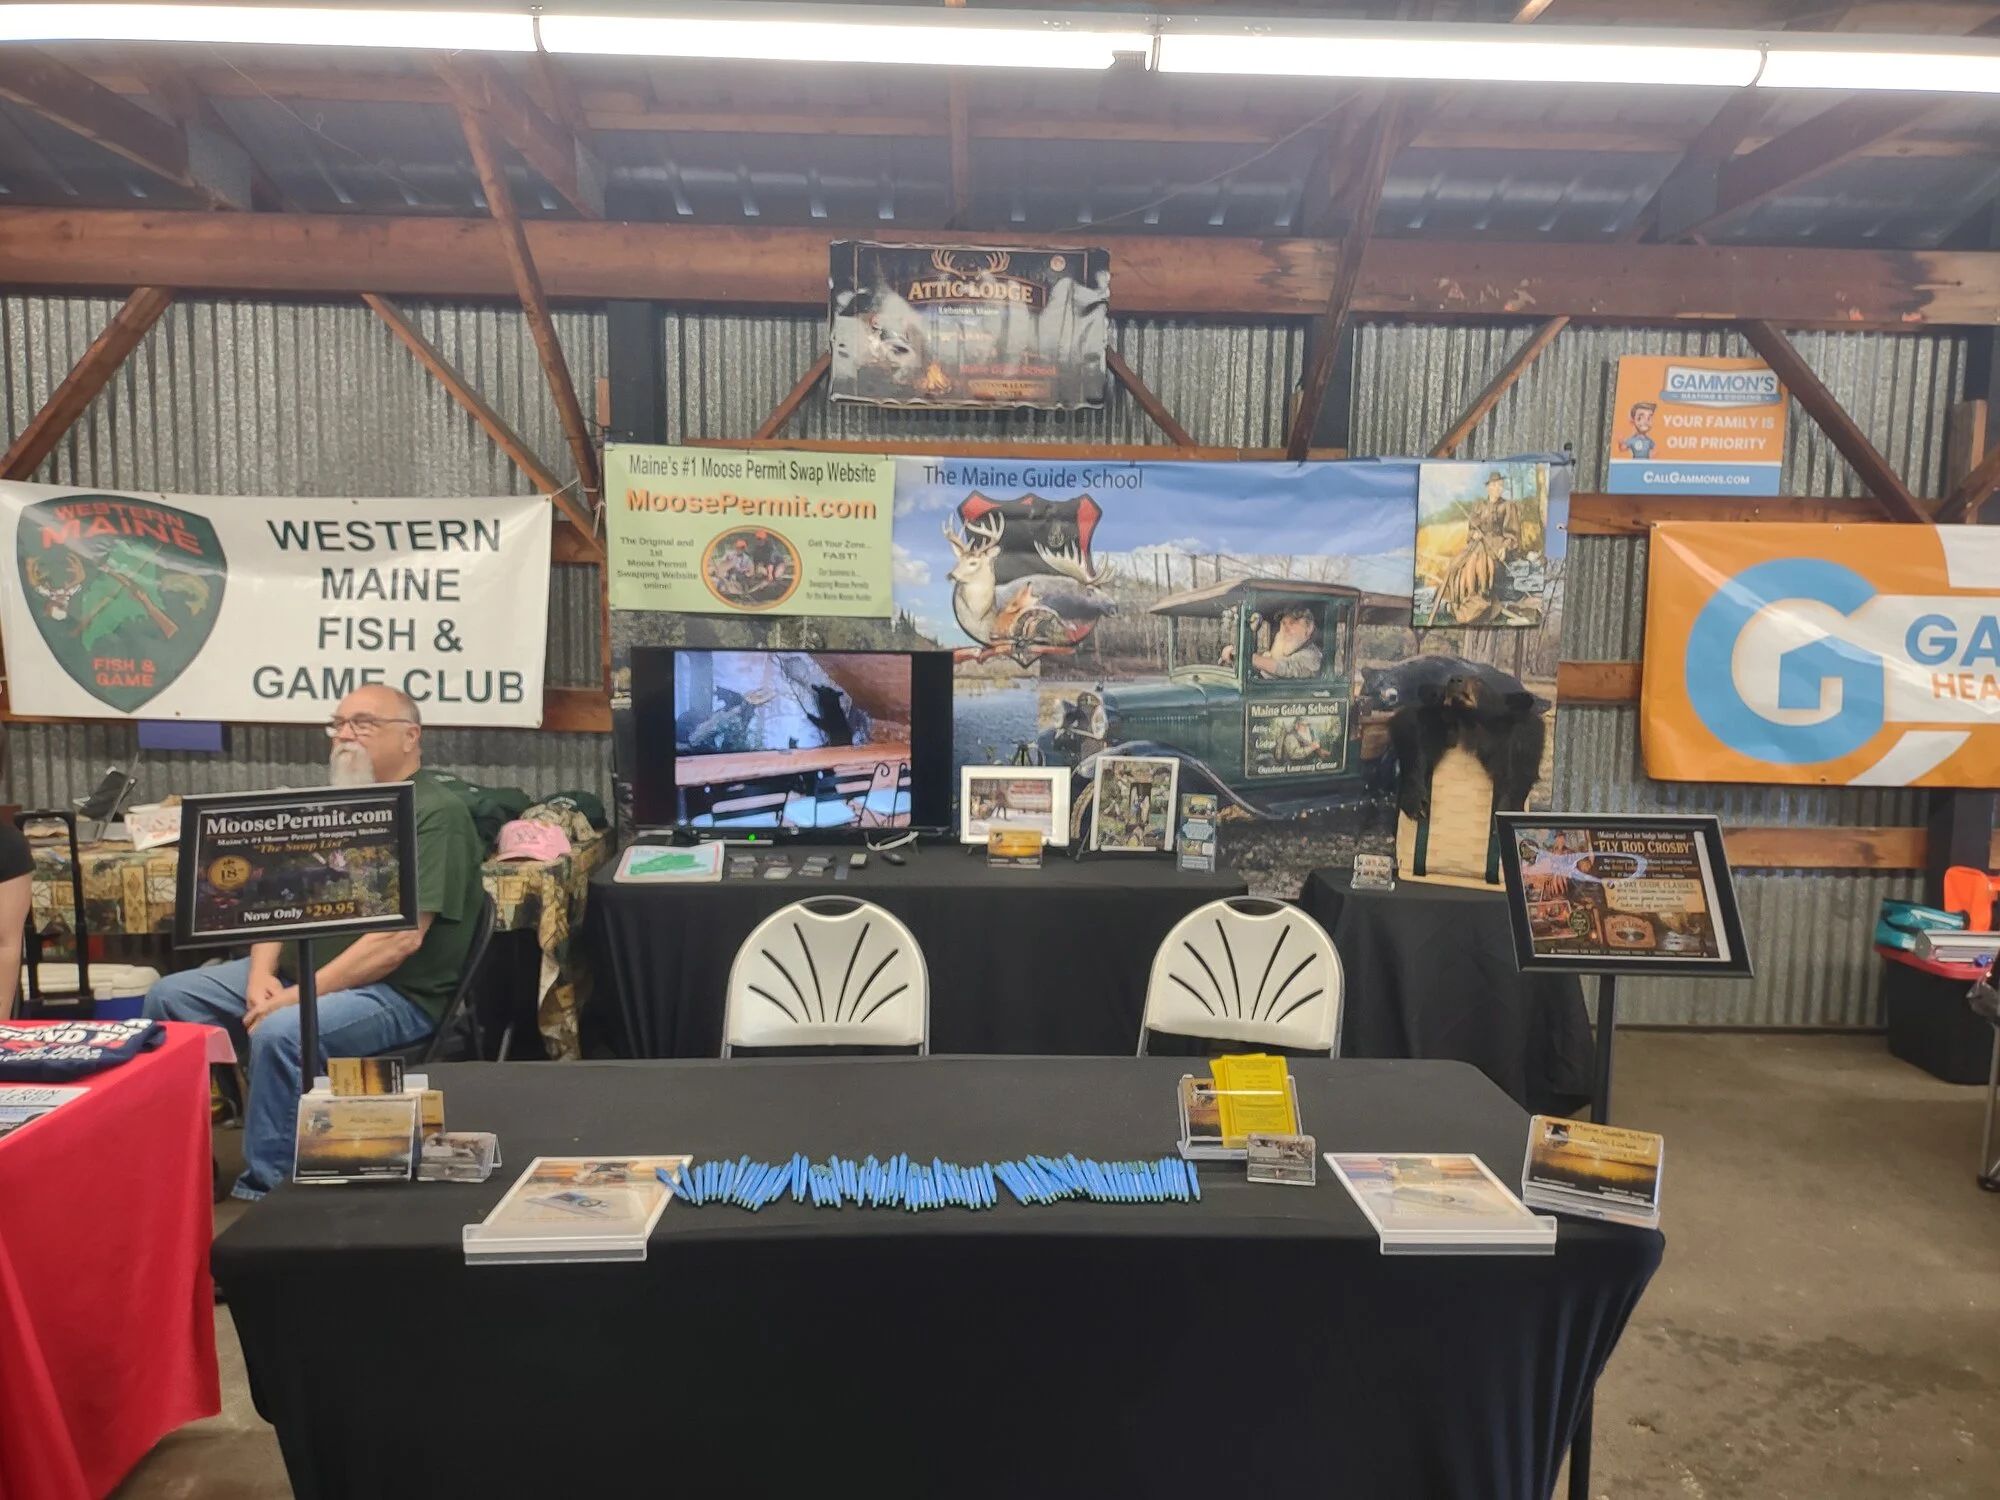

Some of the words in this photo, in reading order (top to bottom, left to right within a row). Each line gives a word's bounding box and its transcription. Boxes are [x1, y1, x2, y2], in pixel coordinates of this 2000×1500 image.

[908, 280, 965, 301] ATTIC
[970, 280, 1033, 303] LODGE
[1671, 374, 1775, 392] GAMMON'S
[1663, 415, 1703, 427] YOUR
[1705, 415, 1758, 429] FAMILY
[1762, 416, 1775, 429] IS
[1666, 436, 1698, 449] OUR
[1700, 436, 1767, 450] PRIORITY
[629, 454, 679, 477] Maine's
[682, 457, 697, 477] #1
[701, 458, 743, 479] Moose
[746, 459, 787, 481] Permit
[790, 460, 823, 486] Swap
[826, 460, 876, 483] Website
[923, 465, 957, 486] The
[961, 466, 1018, 488] Maine
[1023, 467, 1077, 489] Guide
[1082, 468, 1143, 489] School
[626, 487, 877, 520] MoosePermit.com
[42, 515, 204, 555] MAINE
[266, 518, 501, 552] WESTERN
[320, 567, 461, 602] MAINE
[317, 616, 416, 652] FISH
[433, 618, 463, 653] &
[93, 657, 135, 672] FISH
[141, 659, 156, 673] &
[96, 673, 154, 688] GAME
[402, 668, 525, 704] CLUB
[1931, 673, 2000, 702] HEA
[1251, 704, 1280, 717] Maine
[1281, 704, 1307, 716] Guide
[1308, 701, 1339, 714] School
[206, 809, 393, 835] MoosePermit.com
[1621, 840, 1645, 853] ROD
[243, 911, 271, 922] Now
[273, 907, 304, 919] Only
[305, 900, 355, 917] $29.95
